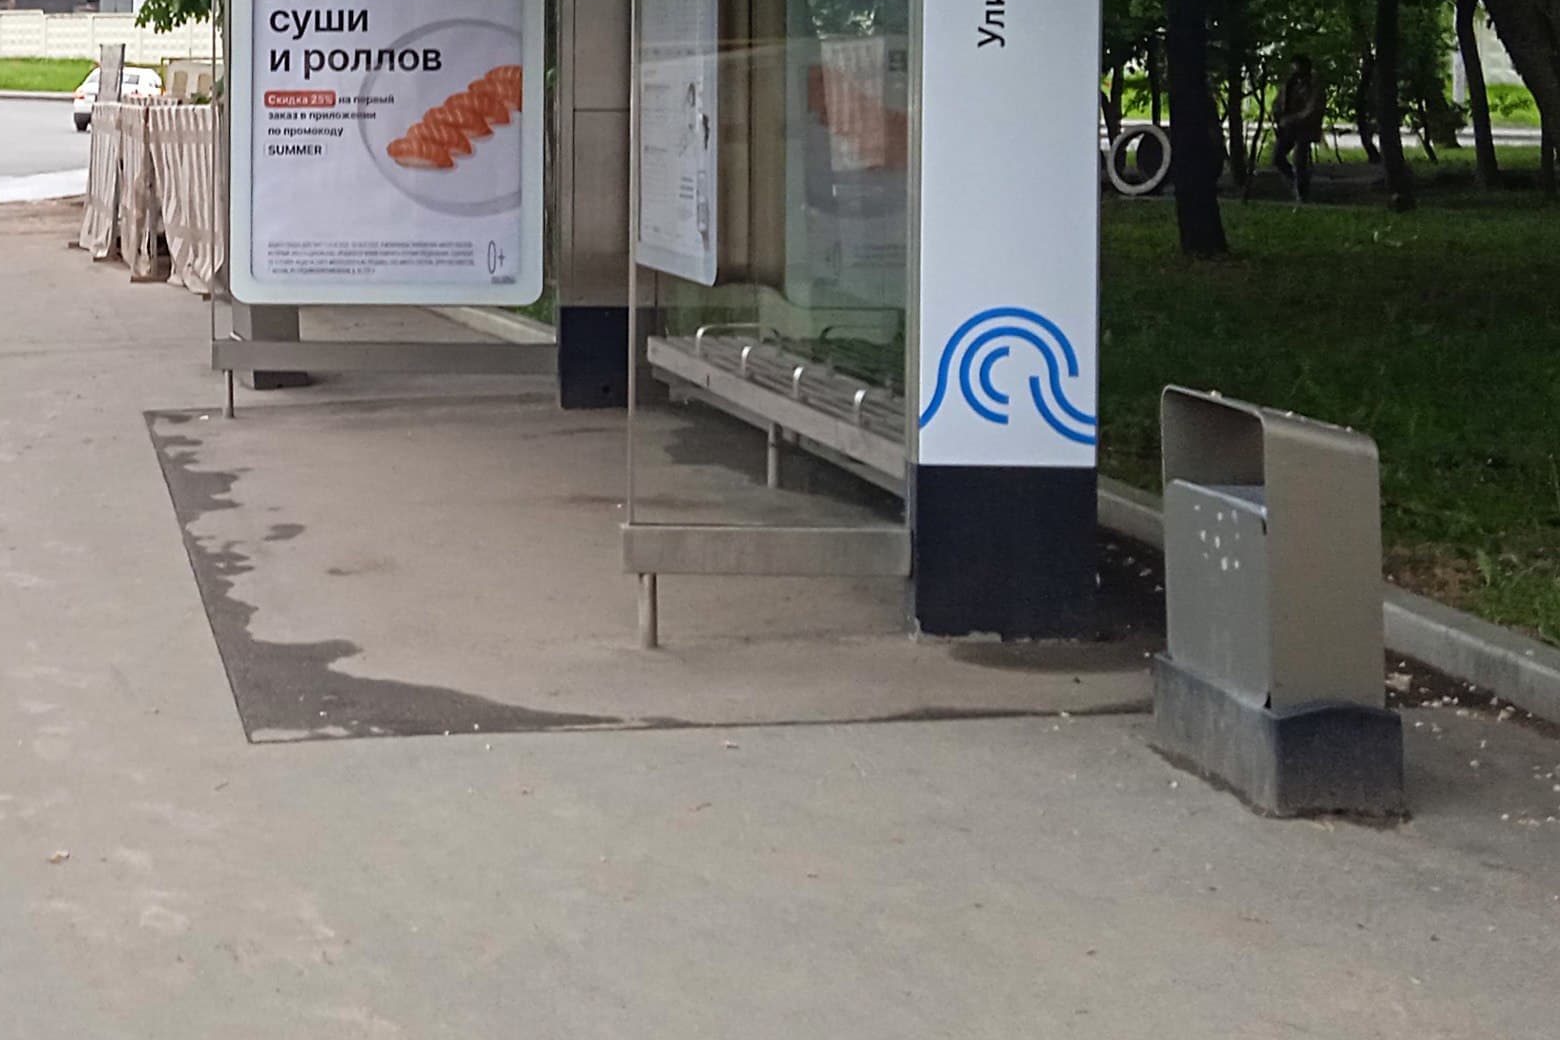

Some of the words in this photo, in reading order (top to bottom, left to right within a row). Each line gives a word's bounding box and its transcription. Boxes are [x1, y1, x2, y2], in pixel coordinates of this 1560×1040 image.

[269, 9, 369, 40] суши
[269, 48, 291, 72] и
[304, 48, 442, 79] роллов
[268, 94, 309, 106] Скидка
[338, 96, 351, 105] на
[353, 94, 395, 107] первый
[268, 112, 298, 120] заказ
[300, 112, 307, 120] в
[309, 112, 377, 122] приложении
[268, 127, 281, 136] по
[283, 127, 344, 138] промокоду
[268, 144, 323, 156] SUMMER
